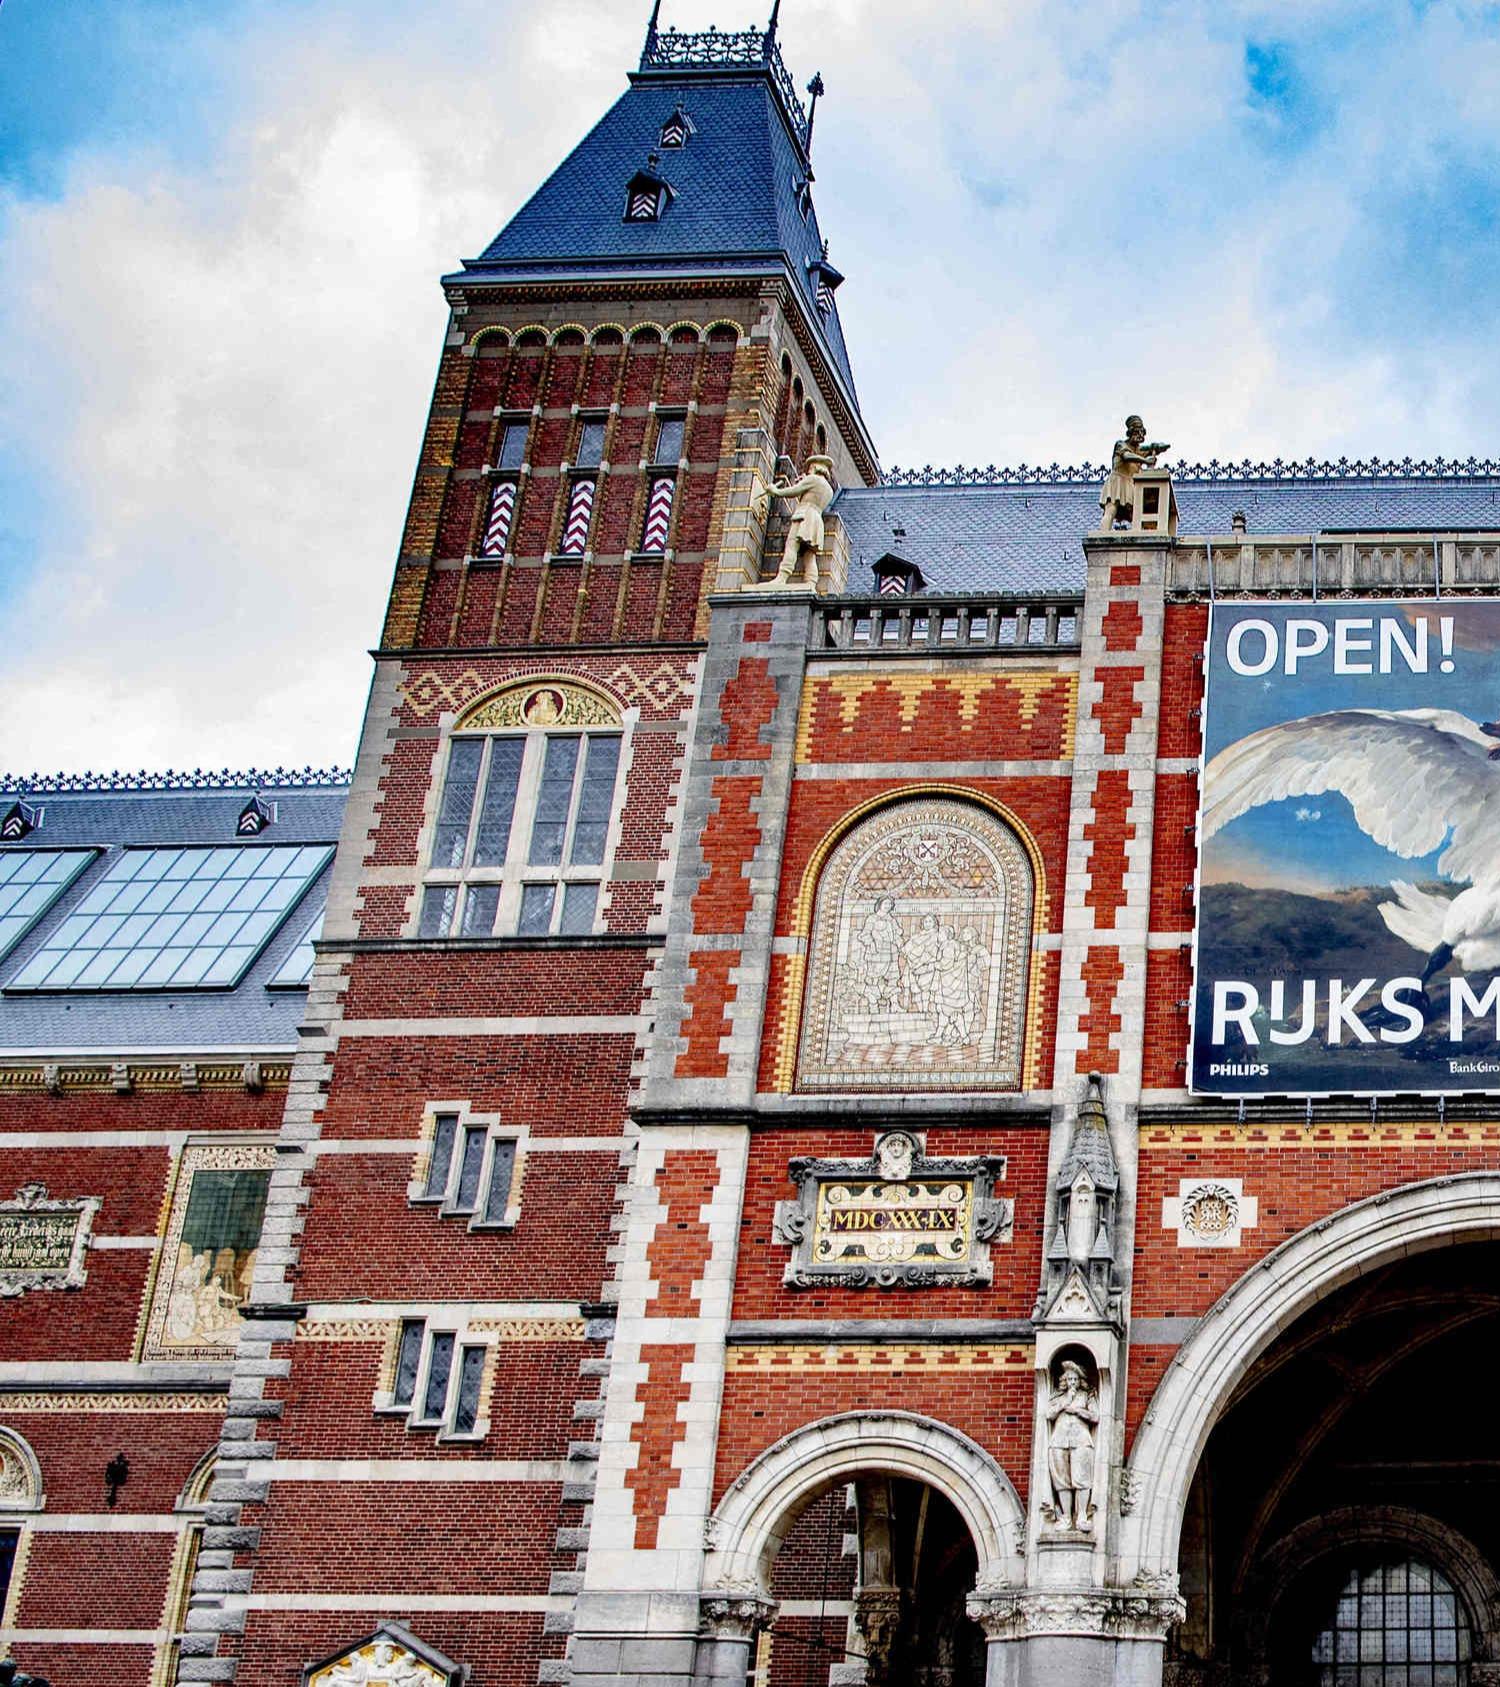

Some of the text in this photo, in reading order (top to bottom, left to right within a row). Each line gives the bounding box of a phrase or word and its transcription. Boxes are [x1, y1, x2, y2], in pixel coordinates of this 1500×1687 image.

[1226, 617, 1455, 677] OPEN!
[1211, 976, 1425, 1046] RIJKS
[1209, 1063, 1270, 1077] PHILIPS
